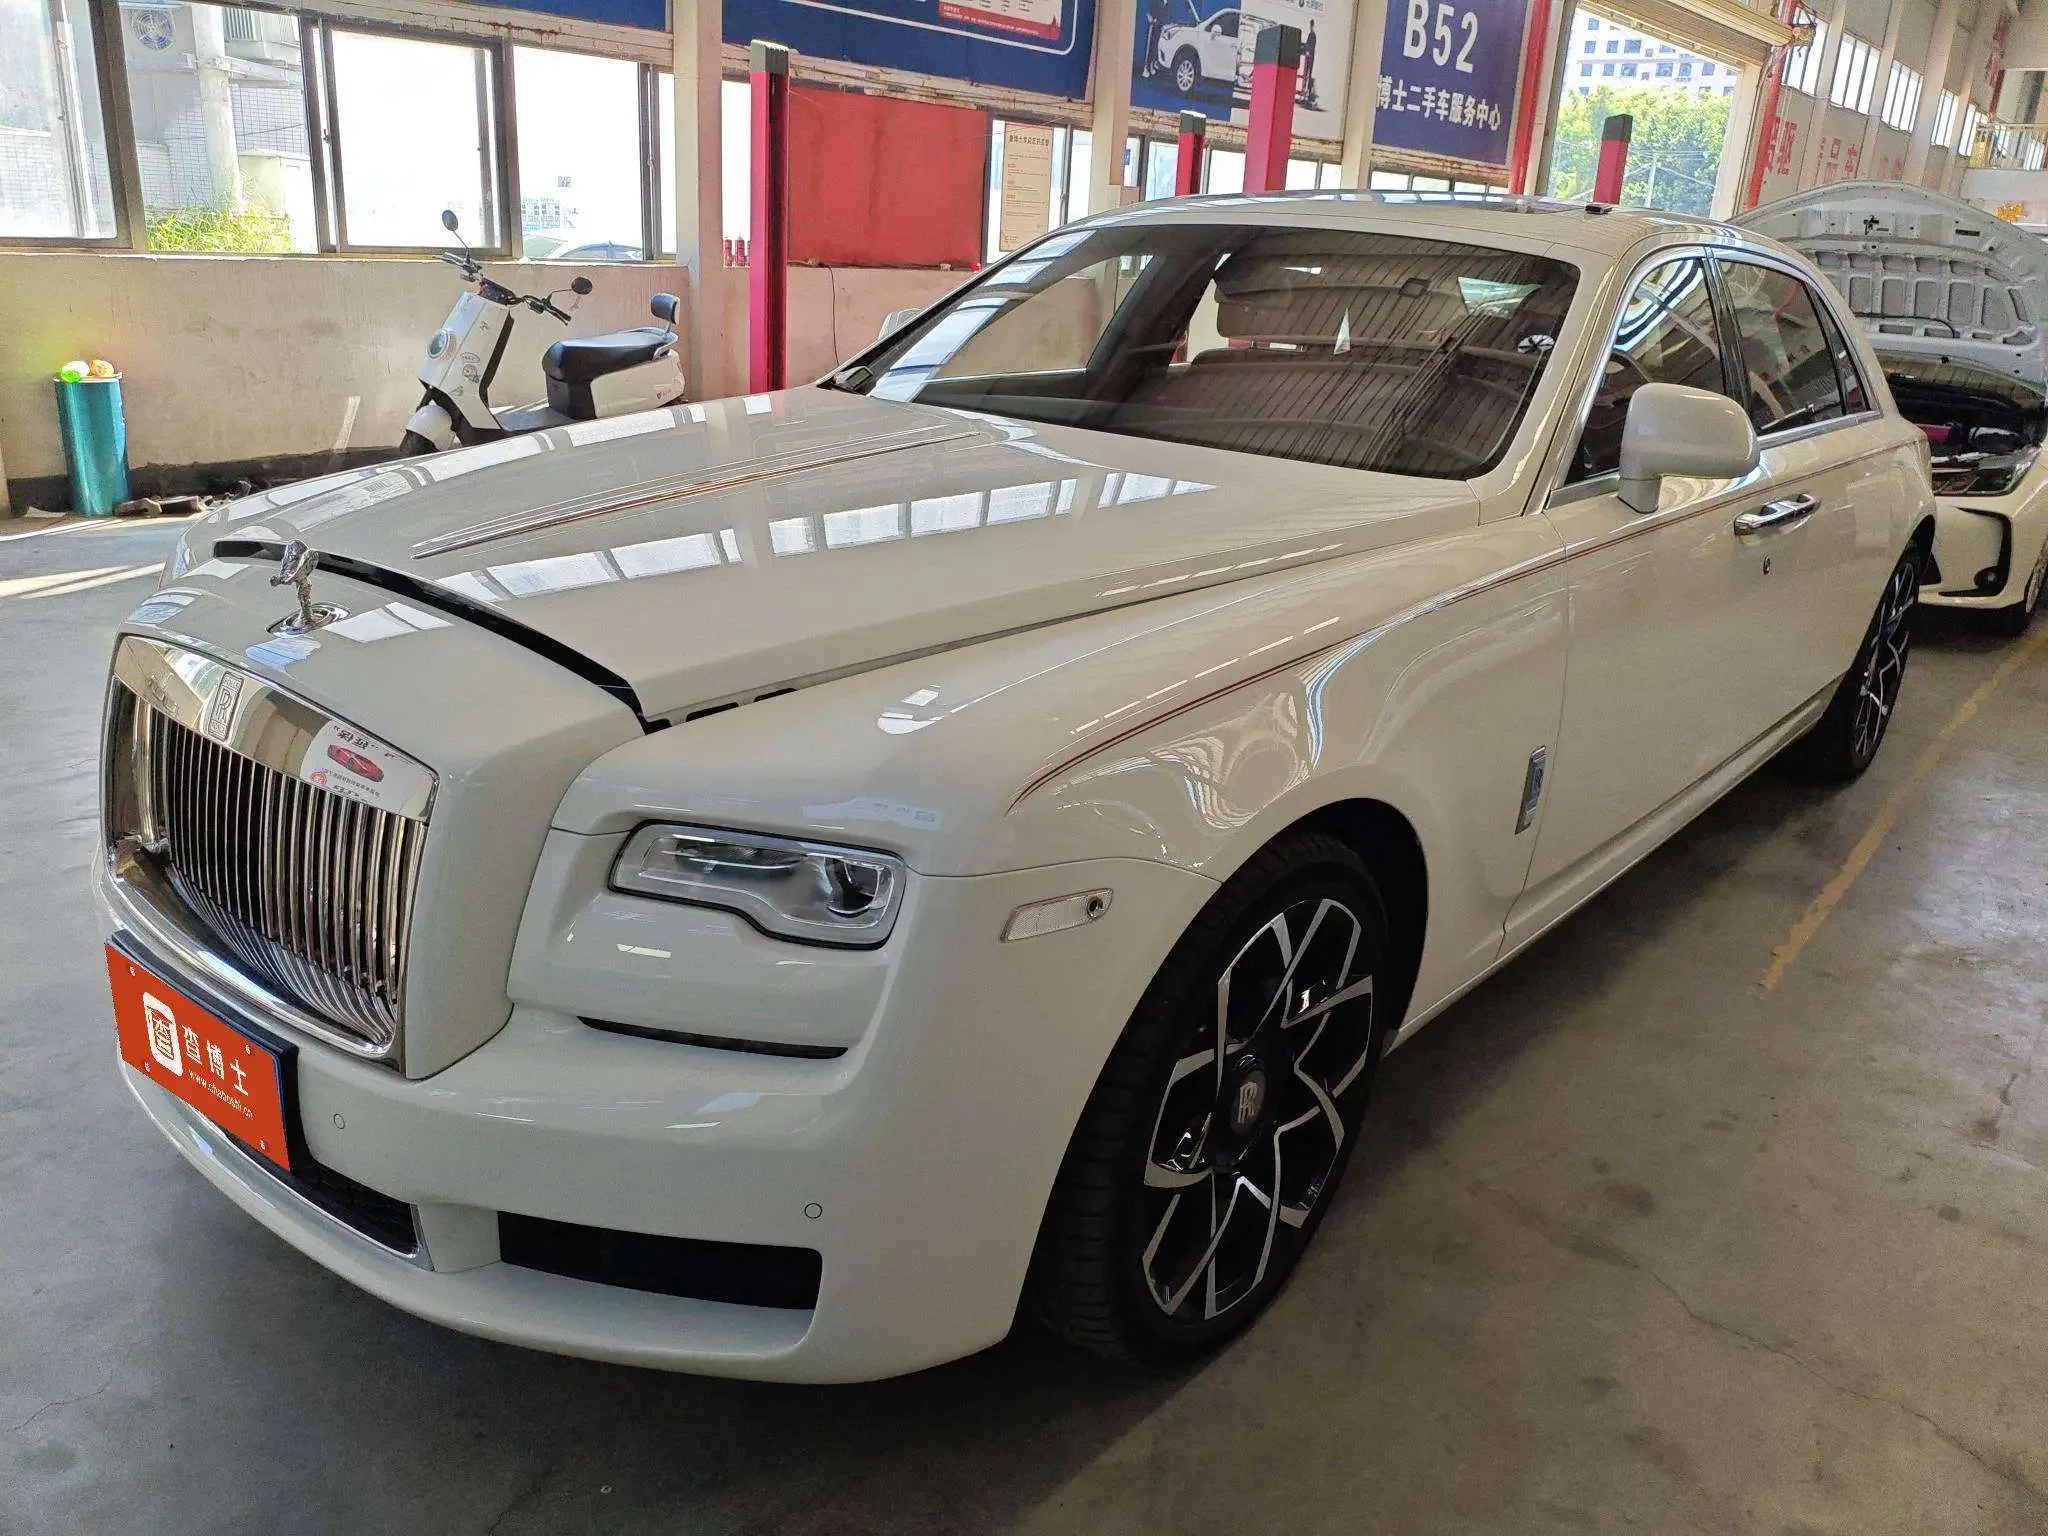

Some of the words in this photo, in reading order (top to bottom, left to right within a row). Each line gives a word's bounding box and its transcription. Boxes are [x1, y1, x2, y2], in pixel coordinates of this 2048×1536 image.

[1403, 0, 1479, 74] B52
[1376, 75, 1501, 131] 博士二手车服务中心
